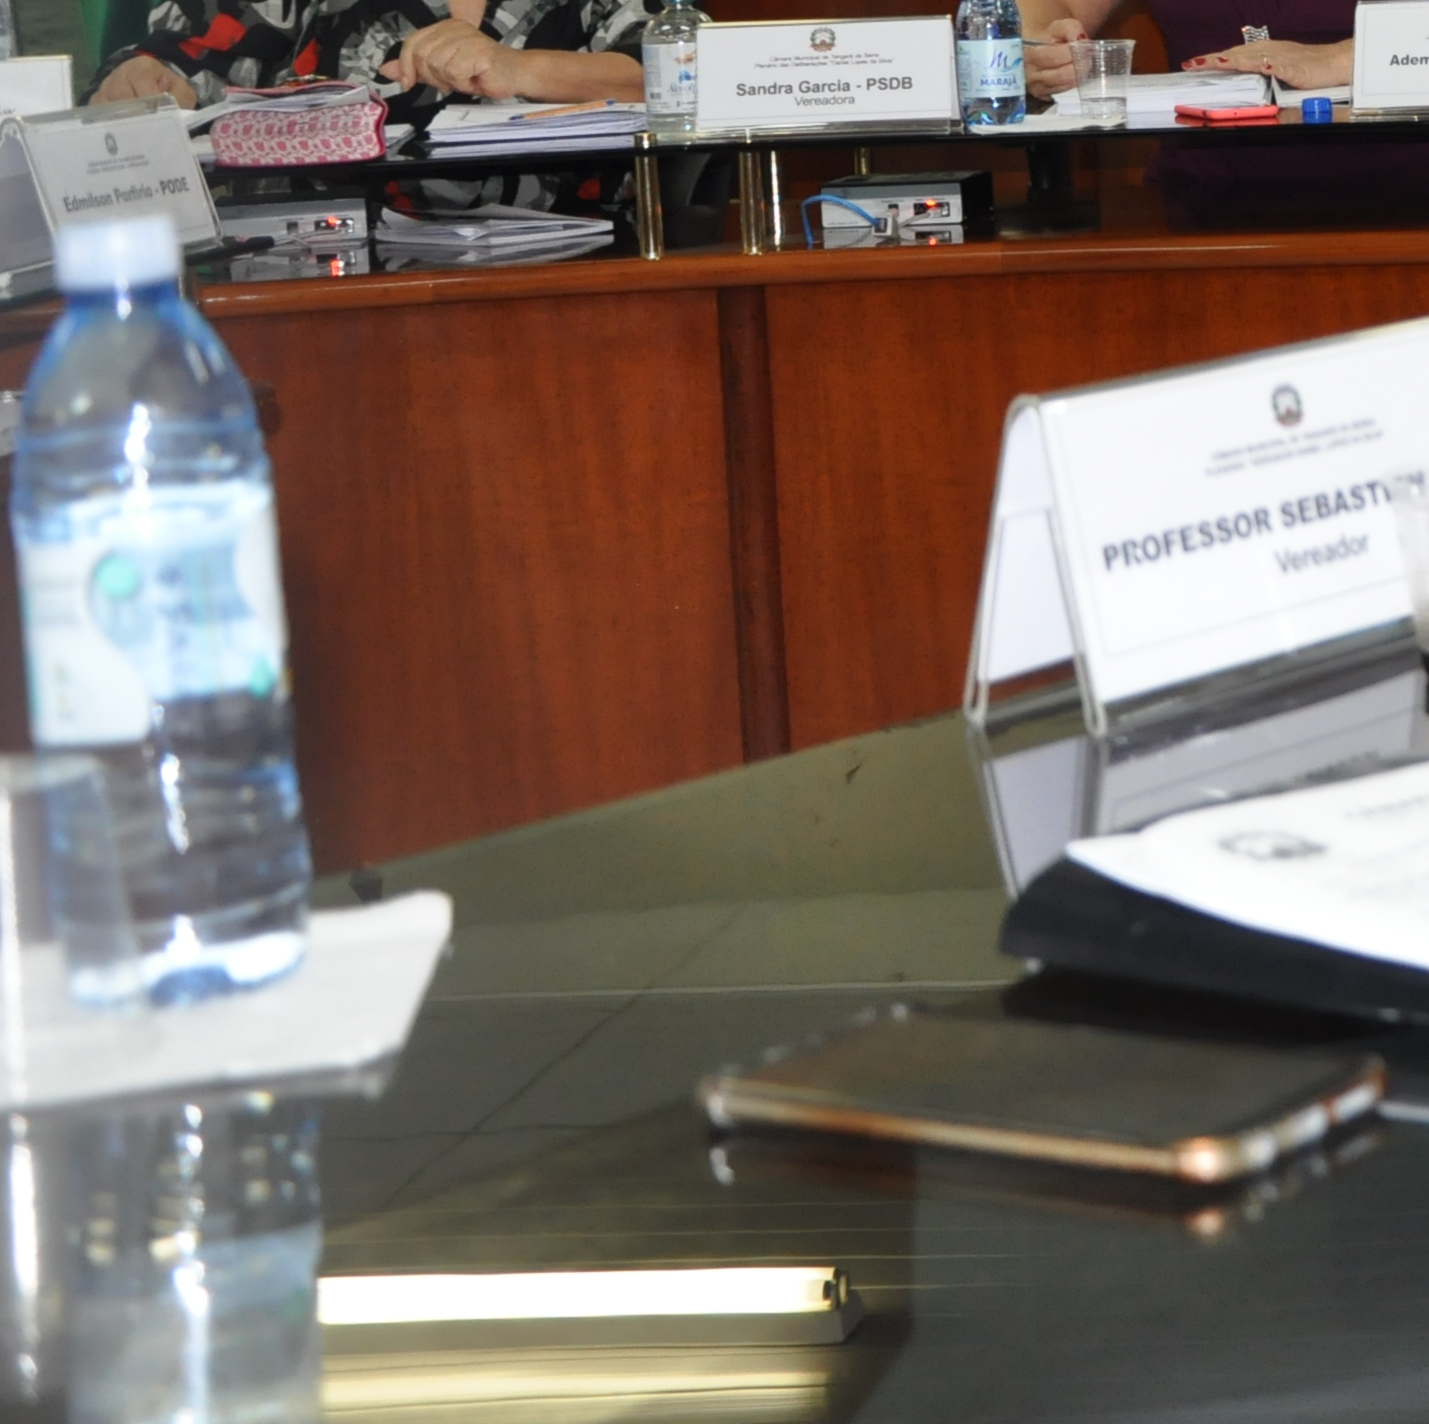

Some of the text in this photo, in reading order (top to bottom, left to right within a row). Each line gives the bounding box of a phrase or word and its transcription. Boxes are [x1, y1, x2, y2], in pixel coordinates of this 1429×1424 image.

[736, 81, 793, 97] Sandra
[798, 79, 851, 95] Garcia
[866, 77, 913, 91] PSDB
[980, 76, 1018, 87] MARAJÁ
[794, 94, 855, 107] Vereadora
[63, 191, 112, 212] Edmilson
[160, 177, 190, 195] PODE
[1103, 507, 1272, 571] PROFESSOR
[1275, 531, 1369, 573] Vereador
